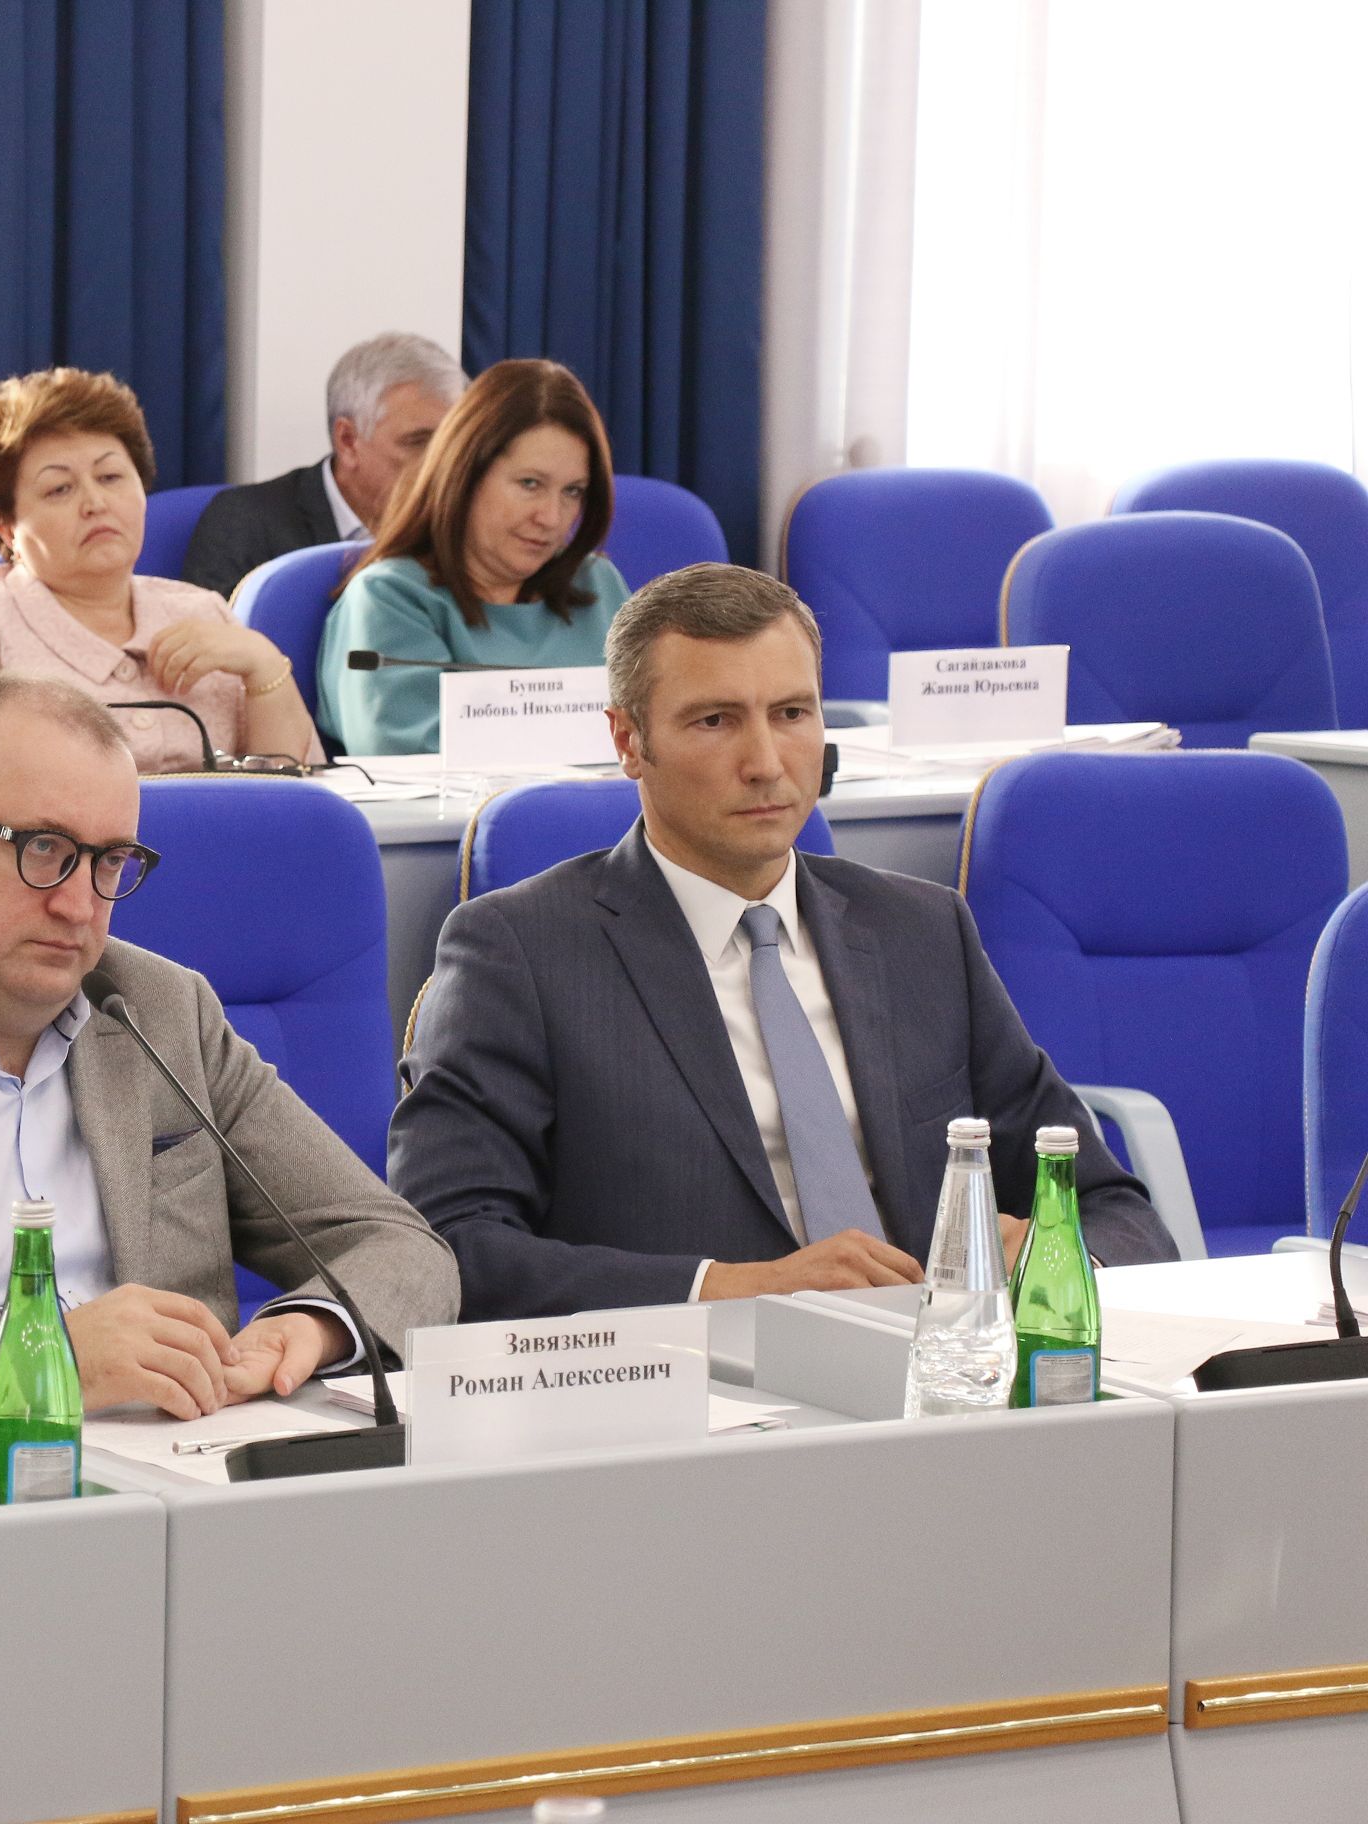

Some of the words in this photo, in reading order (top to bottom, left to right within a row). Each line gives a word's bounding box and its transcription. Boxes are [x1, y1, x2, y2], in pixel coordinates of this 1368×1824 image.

[509, 679, 564, 697] Бунина
[921, 681, 971, 697] Жанна
[974, 678, 1040, 696] Юрьевна
[460, 704, 518, 720] Любовь
[523, 701, 610, 717] Николаевн
[505, 1330, 617, 1356] Завязкин
[449, 1373, 524, 1398] Роман
[531, 1362, 672, 1391] Алексеевич
